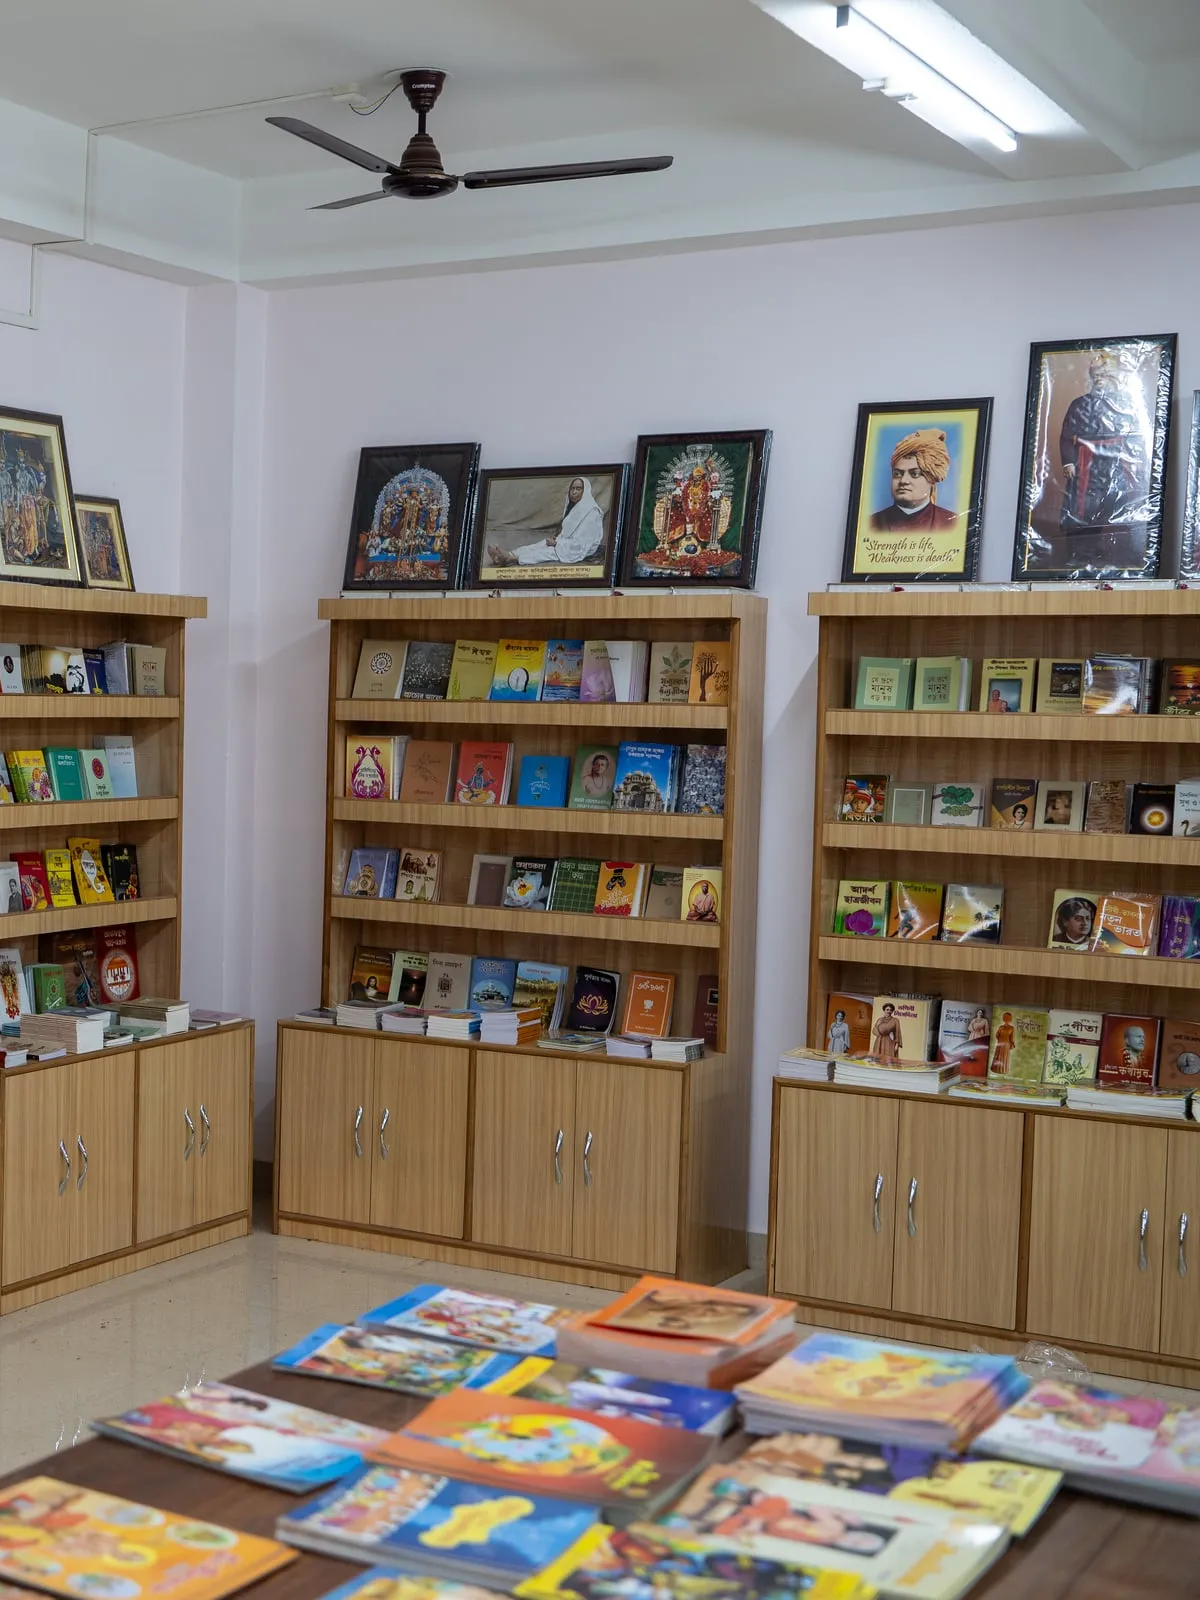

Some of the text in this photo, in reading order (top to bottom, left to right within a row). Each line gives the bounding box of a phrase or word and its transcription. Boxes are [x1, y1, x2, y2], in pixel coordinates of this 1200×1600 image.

[910, 541, 917, 551] is
[918, 537, 935, 551] life,
[869, 552, 914, 563] Weakness
[917, 553, 924, 562] is
[850, 884, 877, 895] আদর্শ
[844, 894, 882, 905] ছাত্রজীবন
[1071, 1020, 1099, 1034] গীতা
